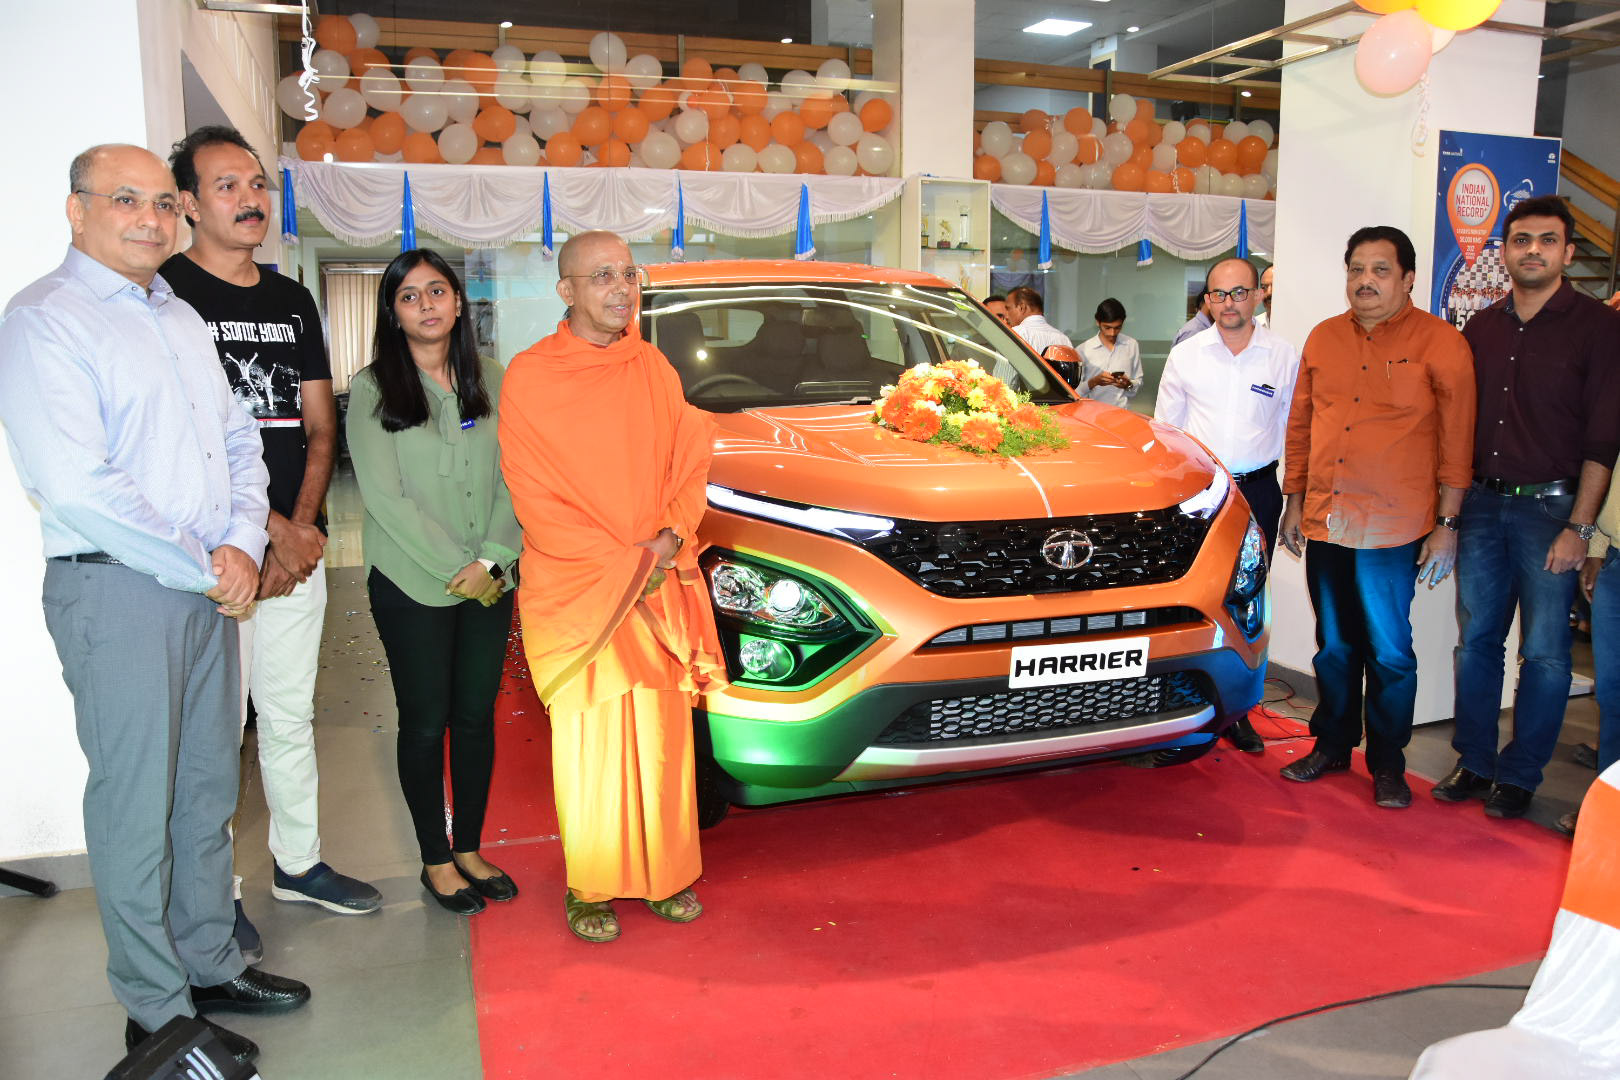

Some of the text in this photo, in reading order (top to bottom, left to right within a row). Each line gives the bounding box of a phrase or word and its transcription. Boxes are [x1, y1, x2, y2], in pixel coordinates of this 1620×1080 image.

[1461, 183, 1486, 195] INDIAN
[1456, 194, 1489, 207] NATIONAL
[220, 321, 260, 342] SONIC
[259, 322, 296, 343] YOUTH
[1014, 649, 1143, 678] HARRIER
